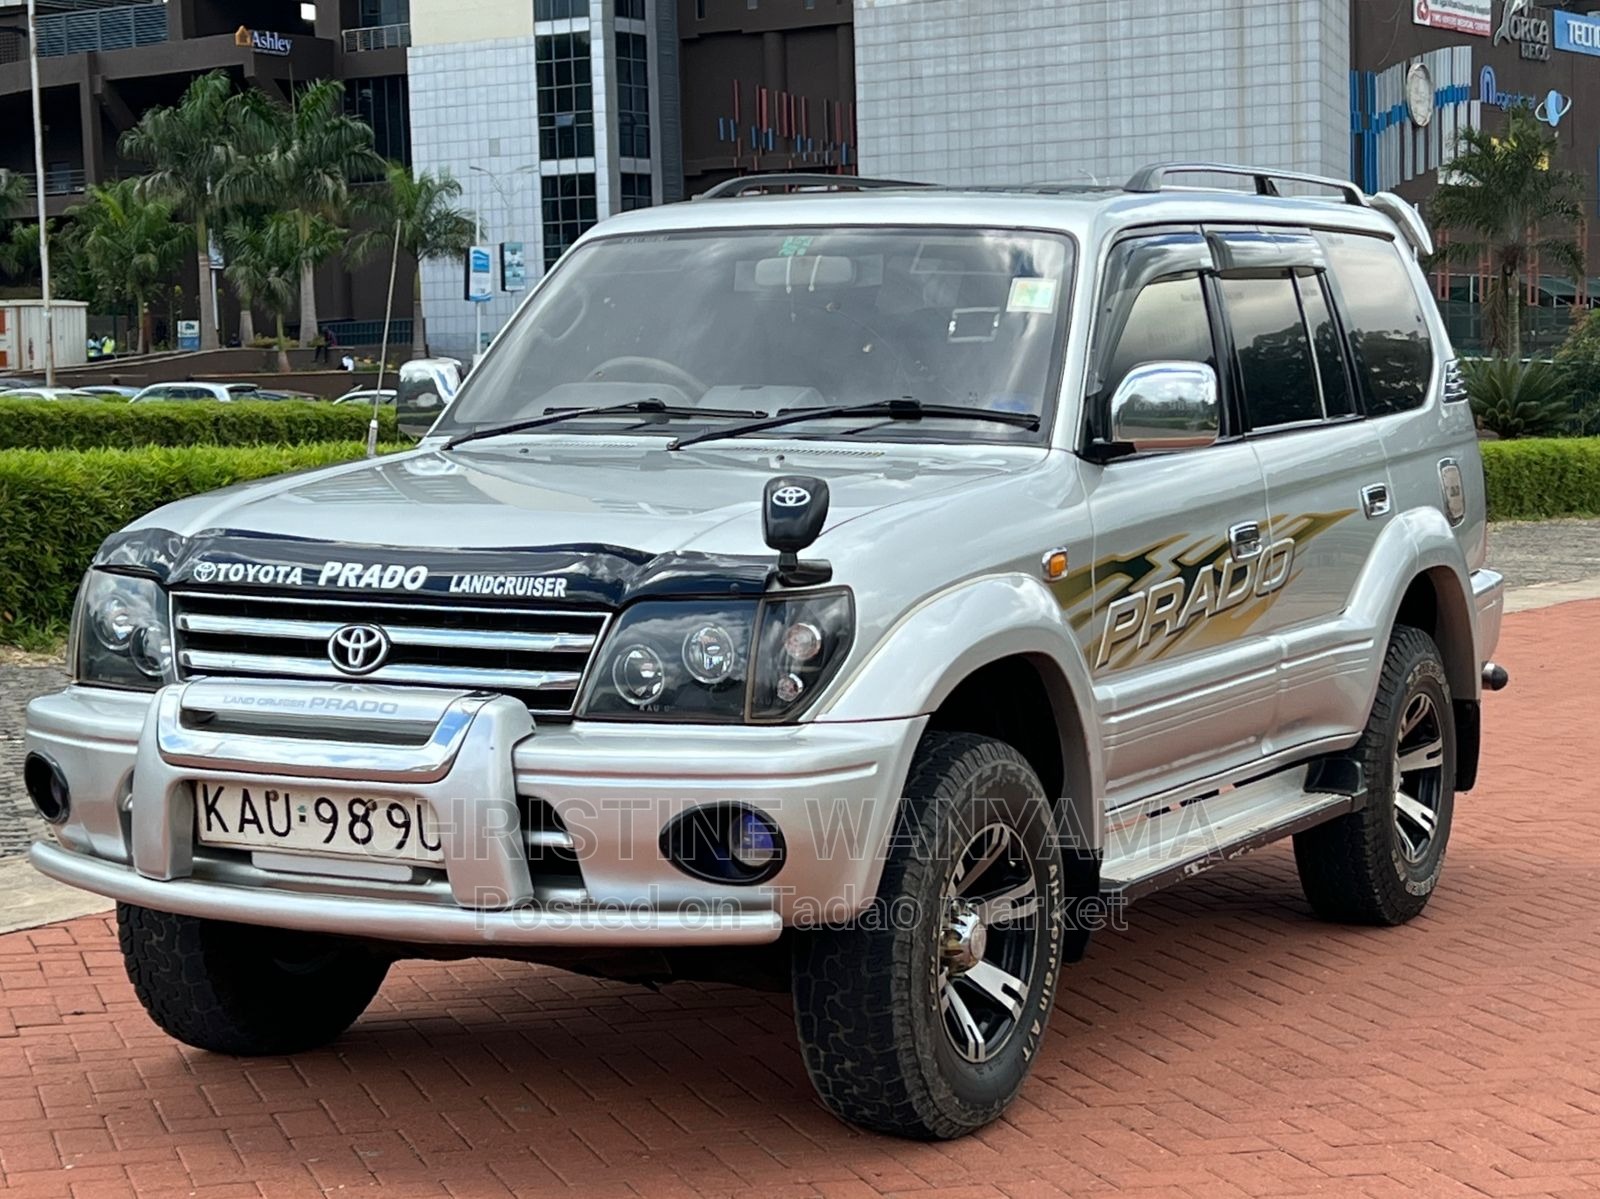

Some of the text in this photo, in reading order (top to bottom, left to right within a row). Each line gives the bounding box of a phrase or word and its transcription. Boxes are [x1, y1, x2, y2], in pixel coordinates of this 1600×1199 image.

[252, 30, 292, 55] Ashley
[1510, 15, 1549, 44] ORCA
[216, 560, 568, 598] TOYOTA PRADO LANDCRUISER
[1094, 536, 1297, 672] PRADO
[223, 695, 399, 715] LAND CRUISER PRADO
[201, 783, 292, 838] KAU
